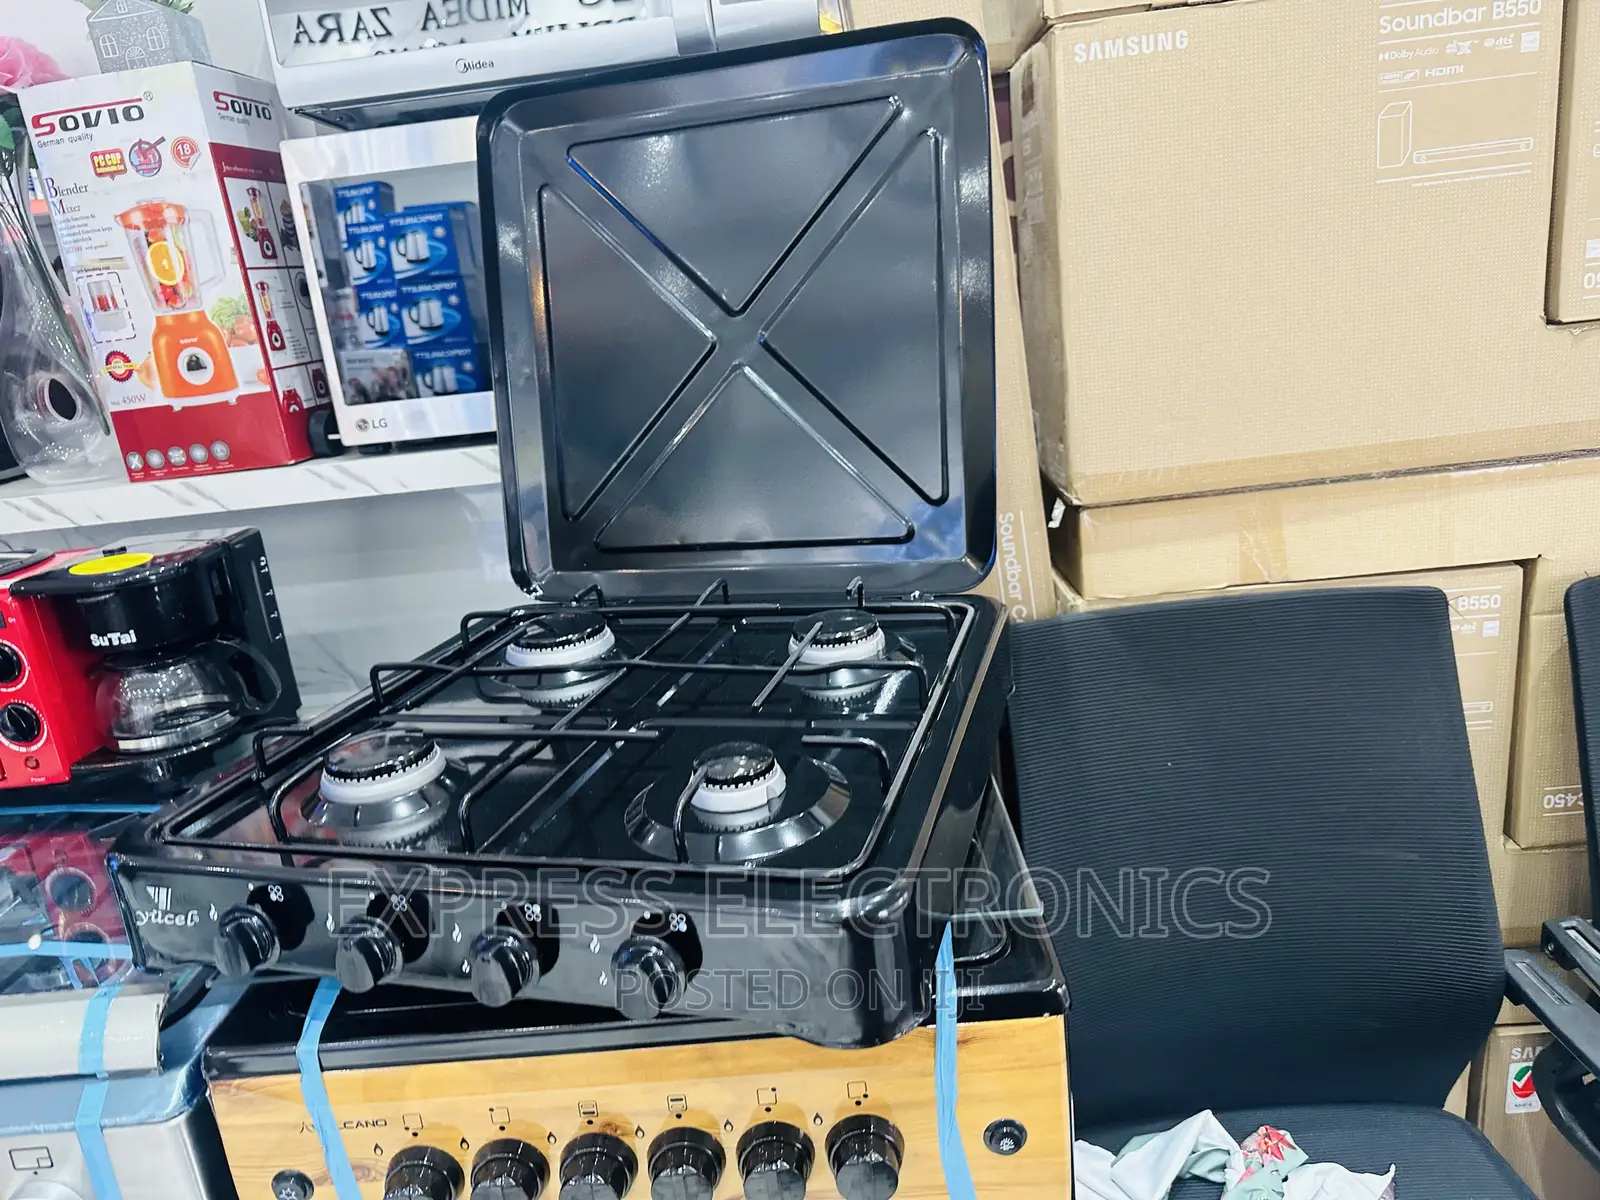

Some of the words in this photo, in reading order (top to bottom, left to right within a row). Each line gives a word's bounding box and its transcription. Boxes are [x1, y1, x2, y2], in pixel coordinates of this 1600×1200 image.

[1379, 6, 1487, 35] Soundbar
[1492, 0, 1541, 21] B550
[1074, 29, 1188, 63] SAMSUNG
[455, 57, 495, 74] Midea
[1425, 64, 1464, 77] HDMI
[37, 137, 65, 149] German
[67, 132, 94, 144] quality
[176, 143, 192, 156] 18
[45, 177, 89, 199] Blender
[51, 199, 81, 217] Mixer
[371, 418, 388, 430] LG
[999, 512, 1023, 600] Soundbar
[1457, 594, 1501, 611] B550
[90, 629, 137, 647] SuTai
